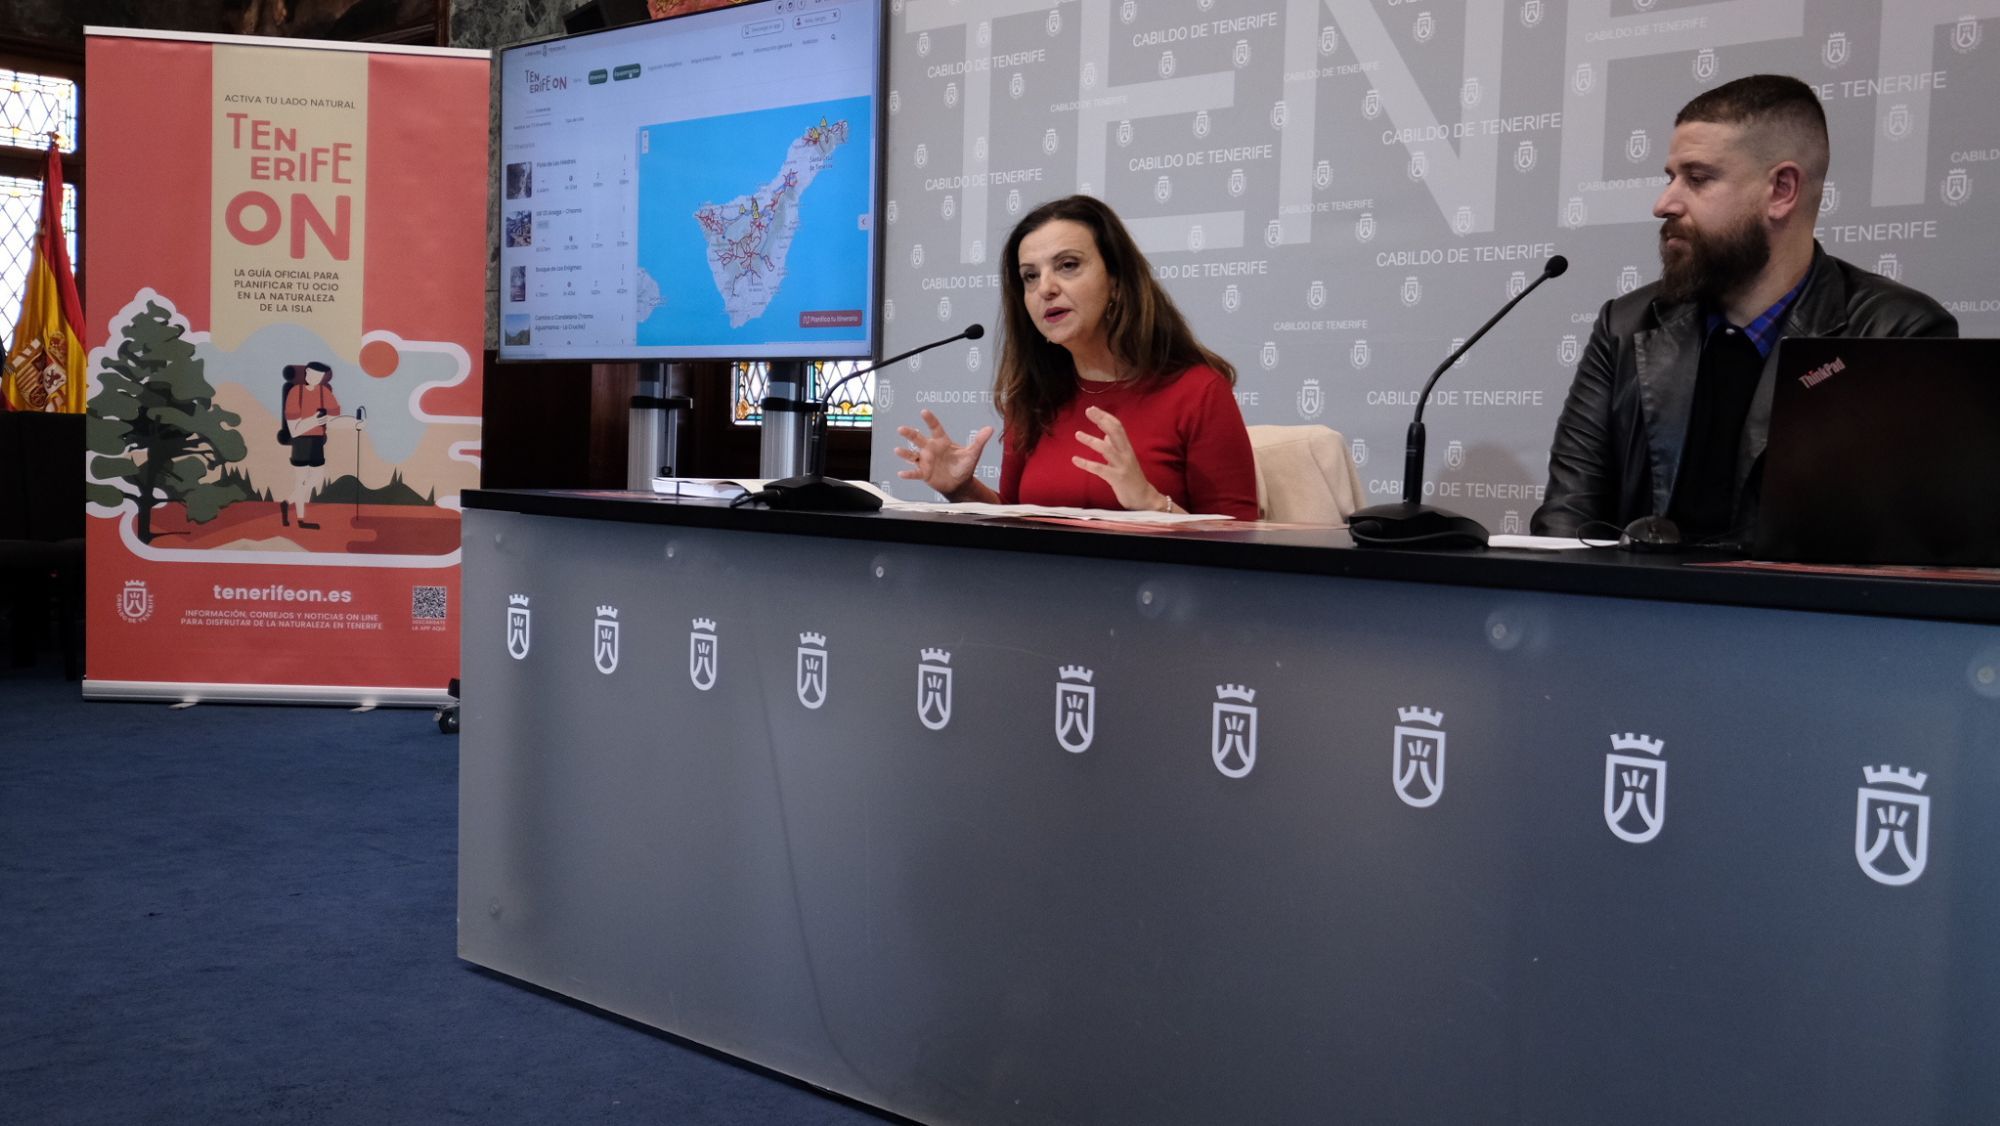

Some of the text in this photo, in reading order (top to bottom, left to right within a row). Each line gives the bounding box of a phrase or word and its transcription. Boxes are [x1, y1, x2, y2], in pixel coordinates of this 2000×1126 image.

[1133, 12, 1278, 48] CABILDO DE TENERIFE
[928, 49, 1046, 79] CABILDO DE TENERIFE
[1285, 61, 1380, 82] CABILDO DE TENERIFE
[1840, 71, 1947, 98] TENERIFE
[224, 94, 356, 109] ACTIVA TU LADO NATURAL
[226, 112, 296, 151] TEN
[1382, 112, 1561, 146] CABILDO DE TENERIFE
[250, 142, 352, 184] ERIFE
[1129, 144, 1272, 172] CABILDO DE TENERIFE
[1950, 148, 2000, 164] CABILD
[925, 168, 1043, 191] CABILDO DE TENERIFE
[1279, 199, 1374, 215] CABILDO DE TENERIFE
[225, 190, 351, 261] ON
[1832, 220, 1937, 243] TENERIFE
[1377, 242, 1555, 267] CABILDO DE TENERIFE
[234, 268, 339, 280] LA GUÍA OFICIAL PARA
[1182, 264, 1200, 278] DE
[1202, 260, 1268, 277] TENERIFE
[234, 280, 339, 292] PLANIFICAR TU OCIO
[922, 276, 966, 290] CABILDO
[968, 276, 983, 288] DE
[237, 291, 335, 302] EN LA NATURALEZA
[259, 303, 313, 313] DE LA ISLA
[1941, 299, 2000, 313] CABILDO
[1273, 319, 1368, 332] CABILDO DE TENERIFE
[1799, 356, 1846, 389] ThinkPad
[916, 390, 960, 403] CABILDO
[962, 390, 977, 403] DE
[1437, 391, 1459, 405] DE
[1463, 390, 1543, 406] TENERIFE
[1369, 479, 1546, 500] CABIO DE TENERIFE
[213, 584, 352, 603] tenerifeon.es
[181, 617, 384, 631] PARA DISFRUTAR DE LA NATURALEZA EN TENERIFE
[249, 611, 294, 619] CONSEJOS
[296, 612, 303, 620] Y
[304, 612, 343, 621] NOTICIAS
[345, 613, 359, 621] ON
[361, 614, 379, 622] LINE
